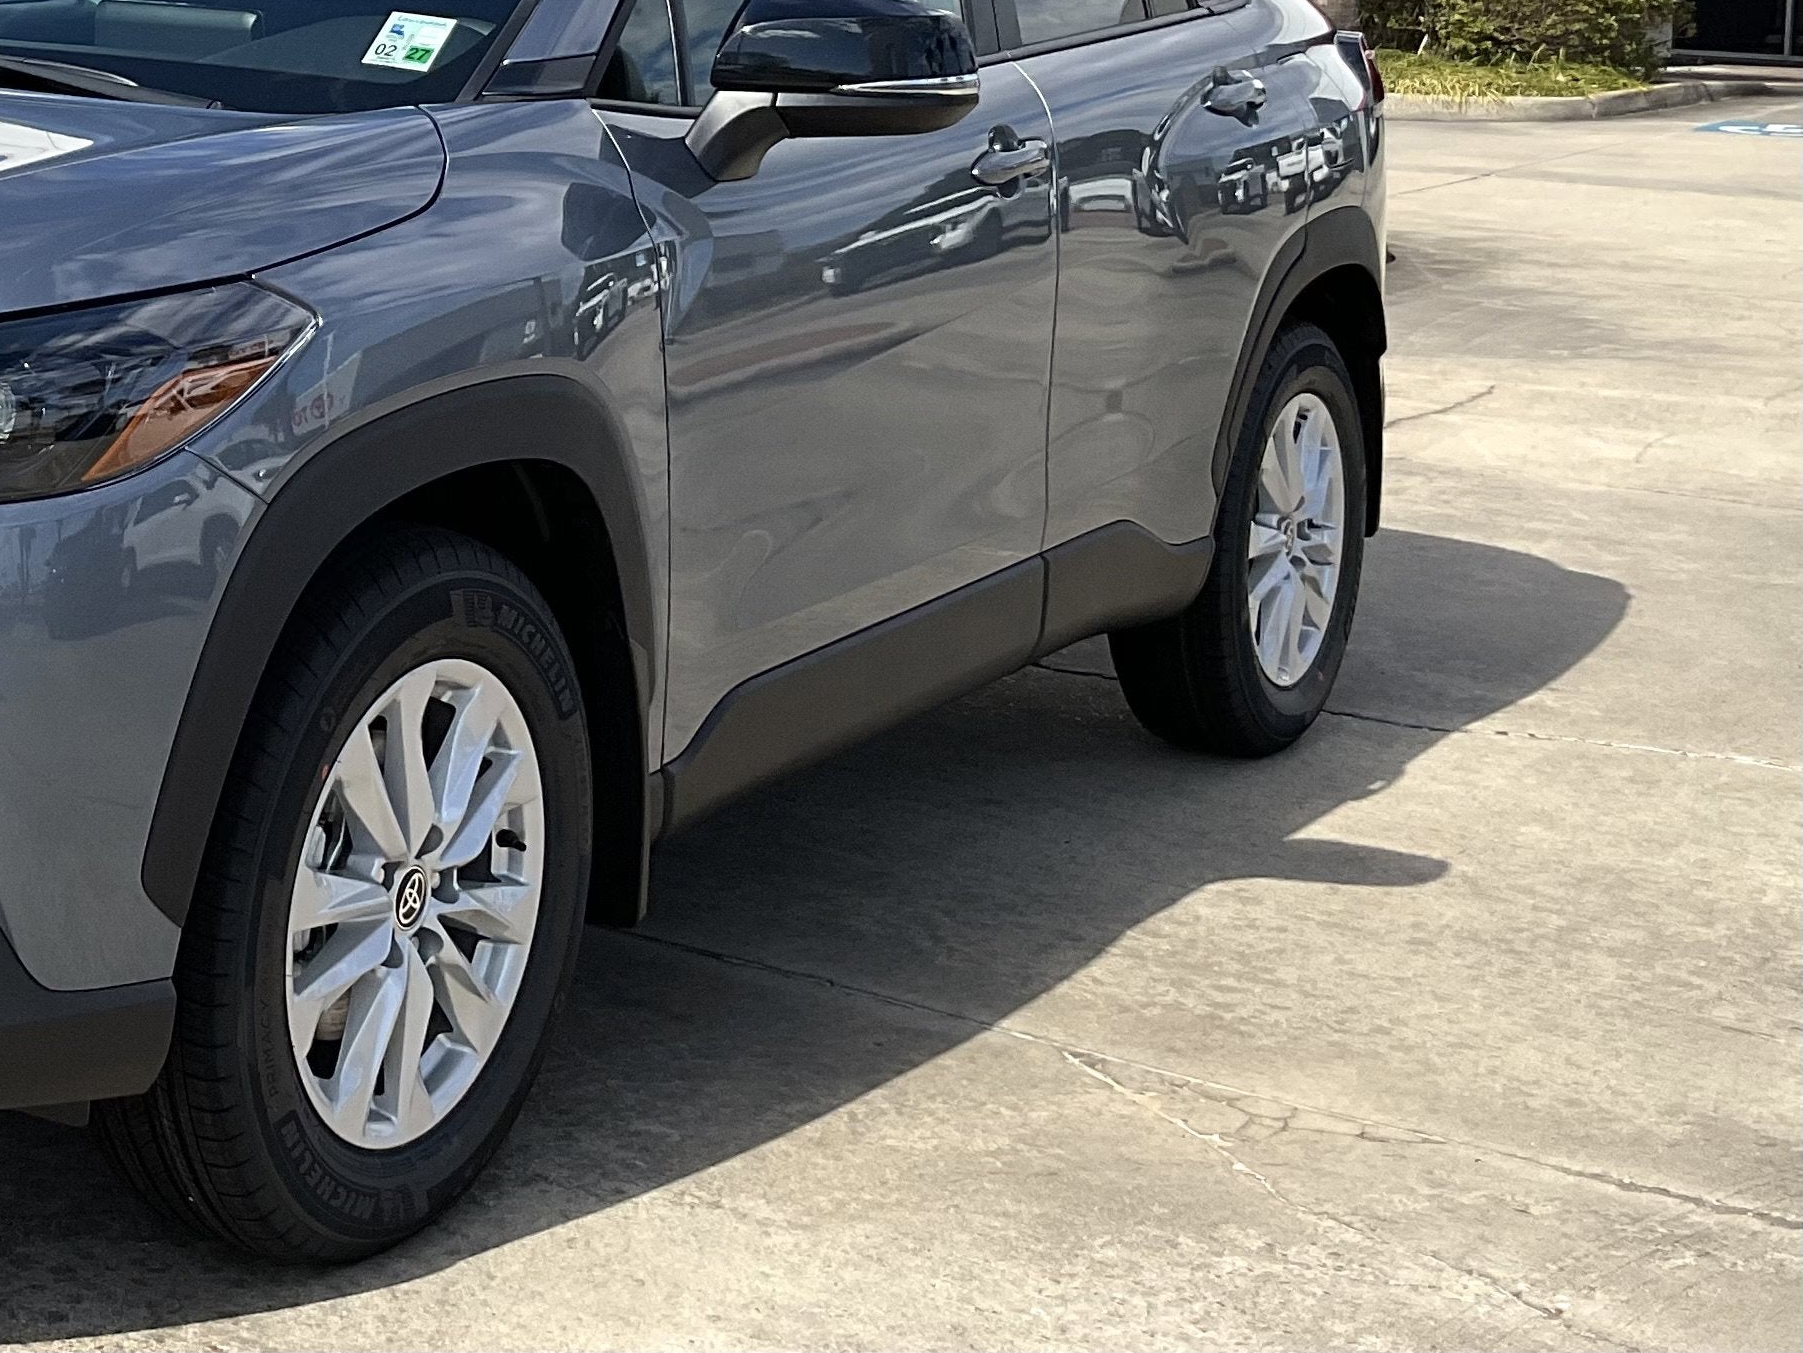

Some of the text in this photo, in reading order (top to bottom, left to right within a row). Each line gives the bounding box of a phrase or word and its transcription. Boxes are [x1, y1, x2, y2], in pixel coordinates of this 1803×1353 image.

[374, 43, 397, 57] 02
[404, 47, 431, 61] 27
[497, 605, 574, 713] MICHELIN
[281, 1120, 377, 1220] MICHELIN
